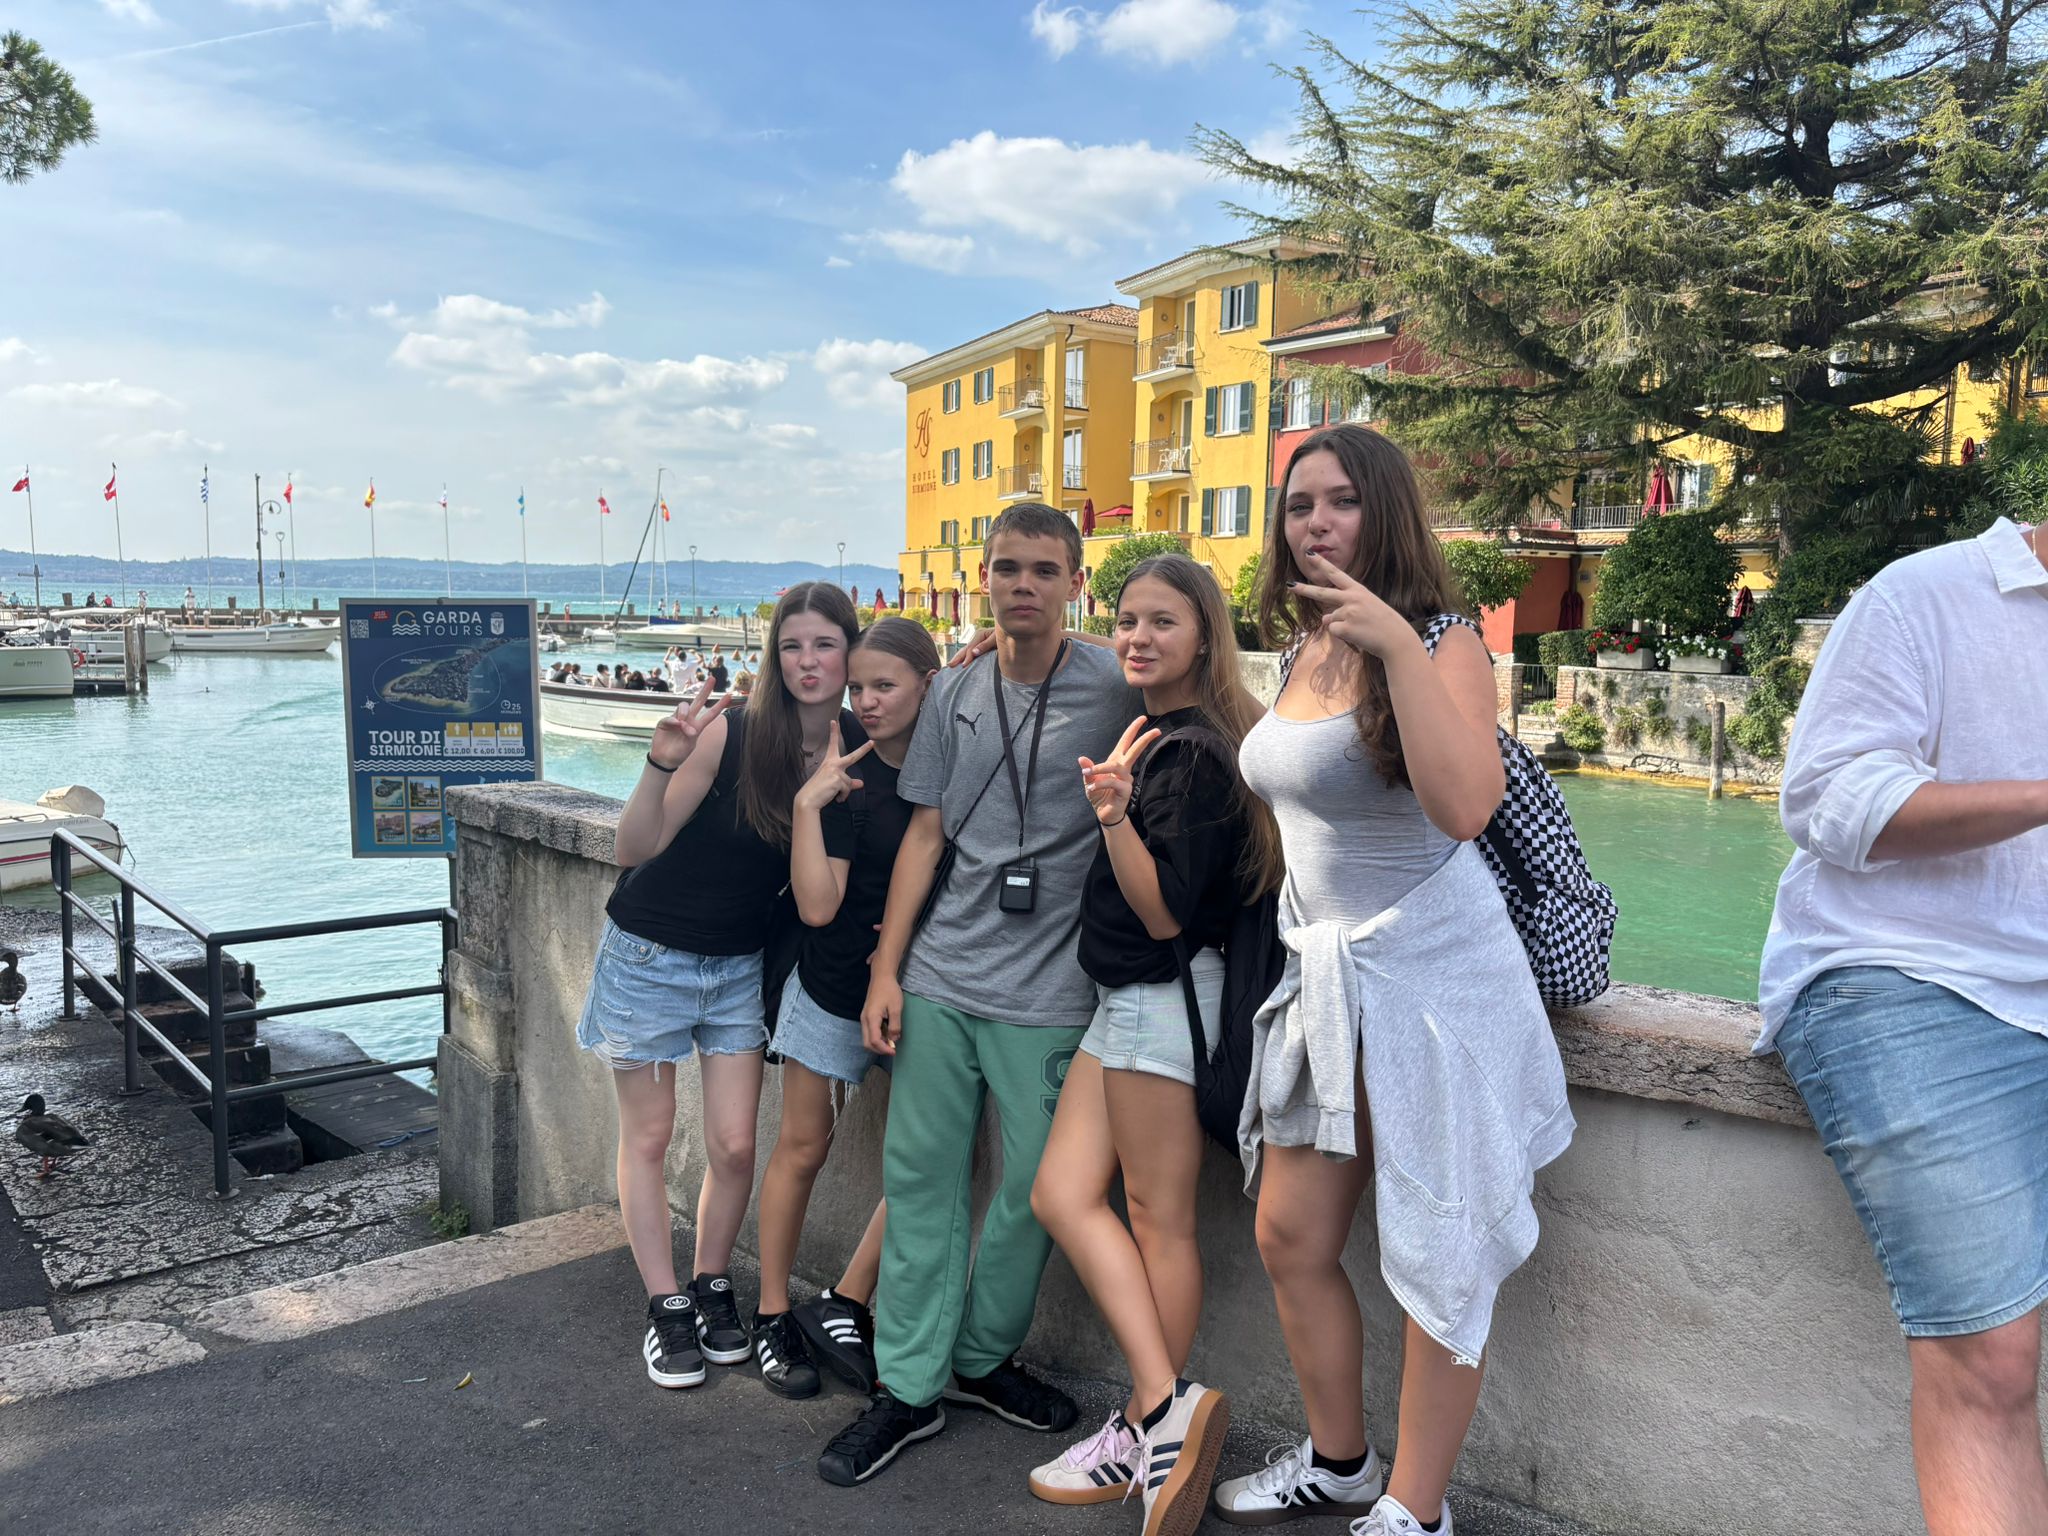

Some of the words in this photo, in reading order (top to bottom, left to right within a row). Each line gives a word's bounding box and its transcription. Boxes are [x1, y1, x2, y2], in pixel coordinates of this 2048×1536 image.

[912, 469, 936, 482] HOTEL
[912, 481, 937, 494] SIRMIONE
[422, 611, 482, 624] GARDA
[423, 625, 483, 636] TOURS
[368, 730, 418, 744] TOUR
[420, 730, 441, 743] DI
[369, 745, 442, 757] SIRMIONE
